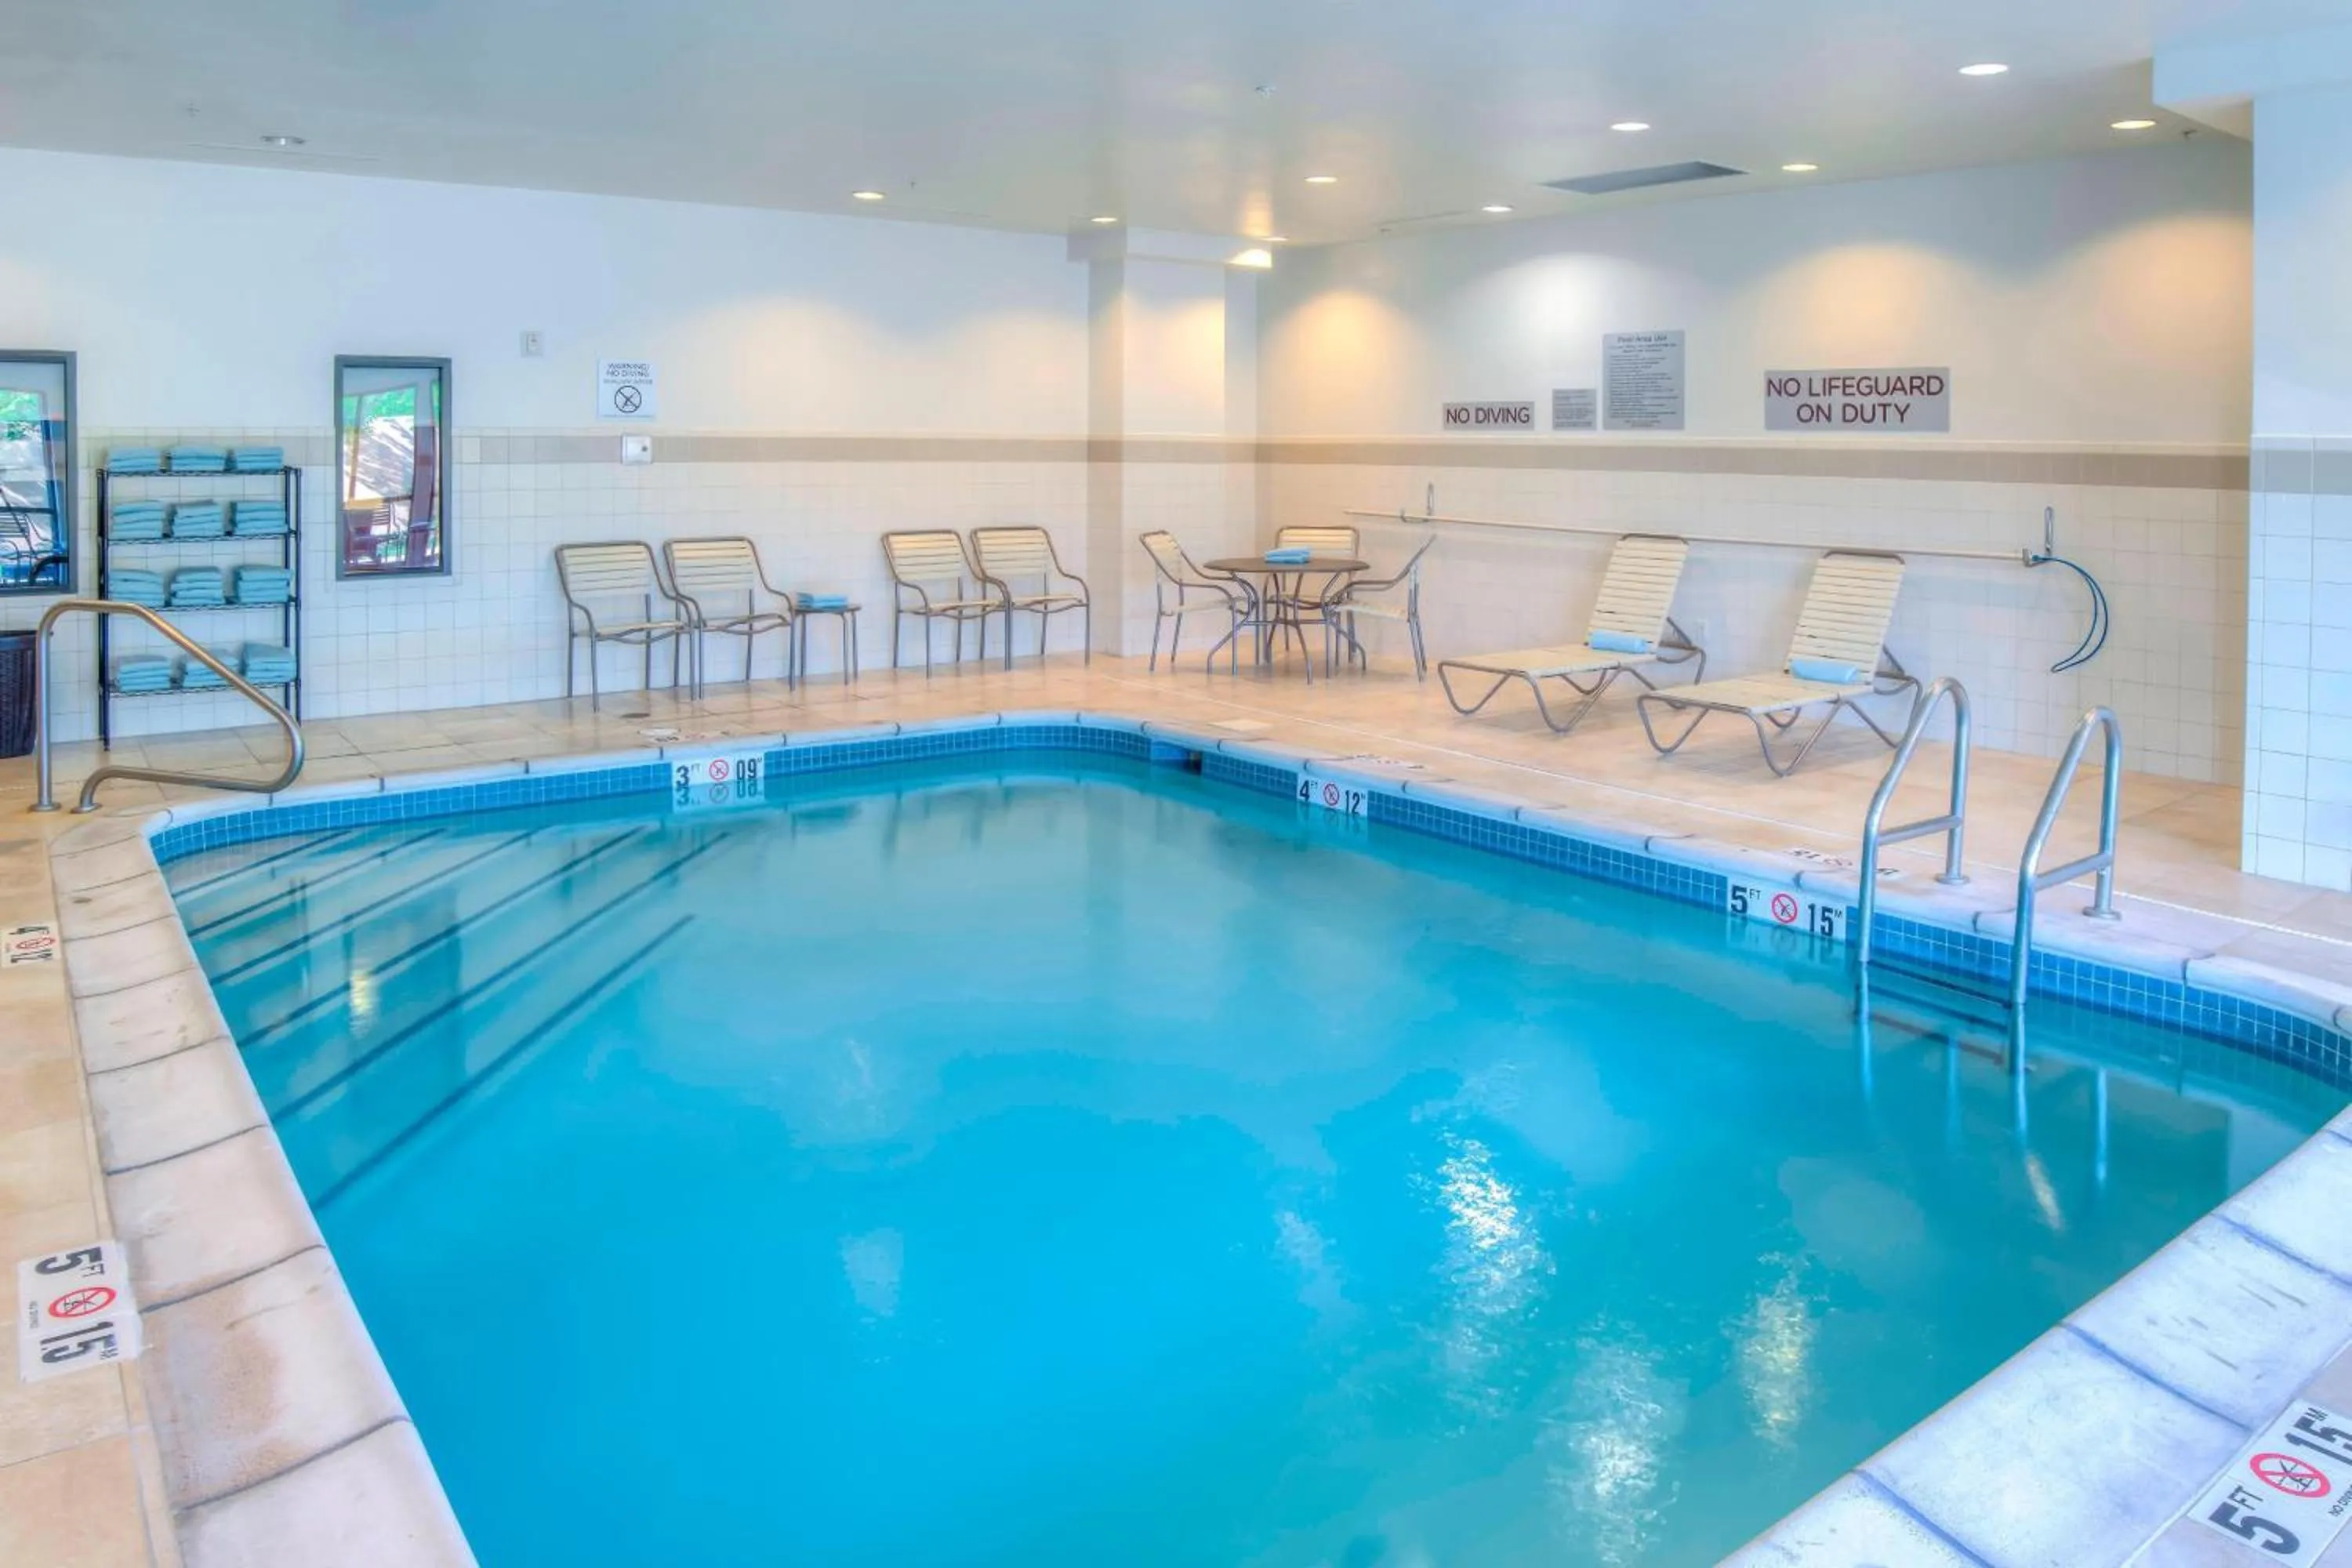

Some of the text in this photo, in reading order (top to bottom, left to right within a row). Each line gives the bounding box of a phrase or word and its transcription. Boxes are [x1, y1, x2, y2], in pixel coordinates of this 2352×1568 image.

[1766, 376, 1945, 397] NO LIFEGUARD
[1446, 407, 1530, 424] NO DIVING
[1796, 403, 1911, 423] ON DUTY
[676, 765, 690, 787] 3
[1299, 779, 1310, 802] 4
[1731, 884, 1748, 914] 5
[1749, 888, 1761, 900] FT
[34, 1247, 103, 1275] 5
[81, 1264, 105, 1277] FT
[2227, 1484, 2264, 1511] FT
[2208, 1501, 2300, 1555] 5
